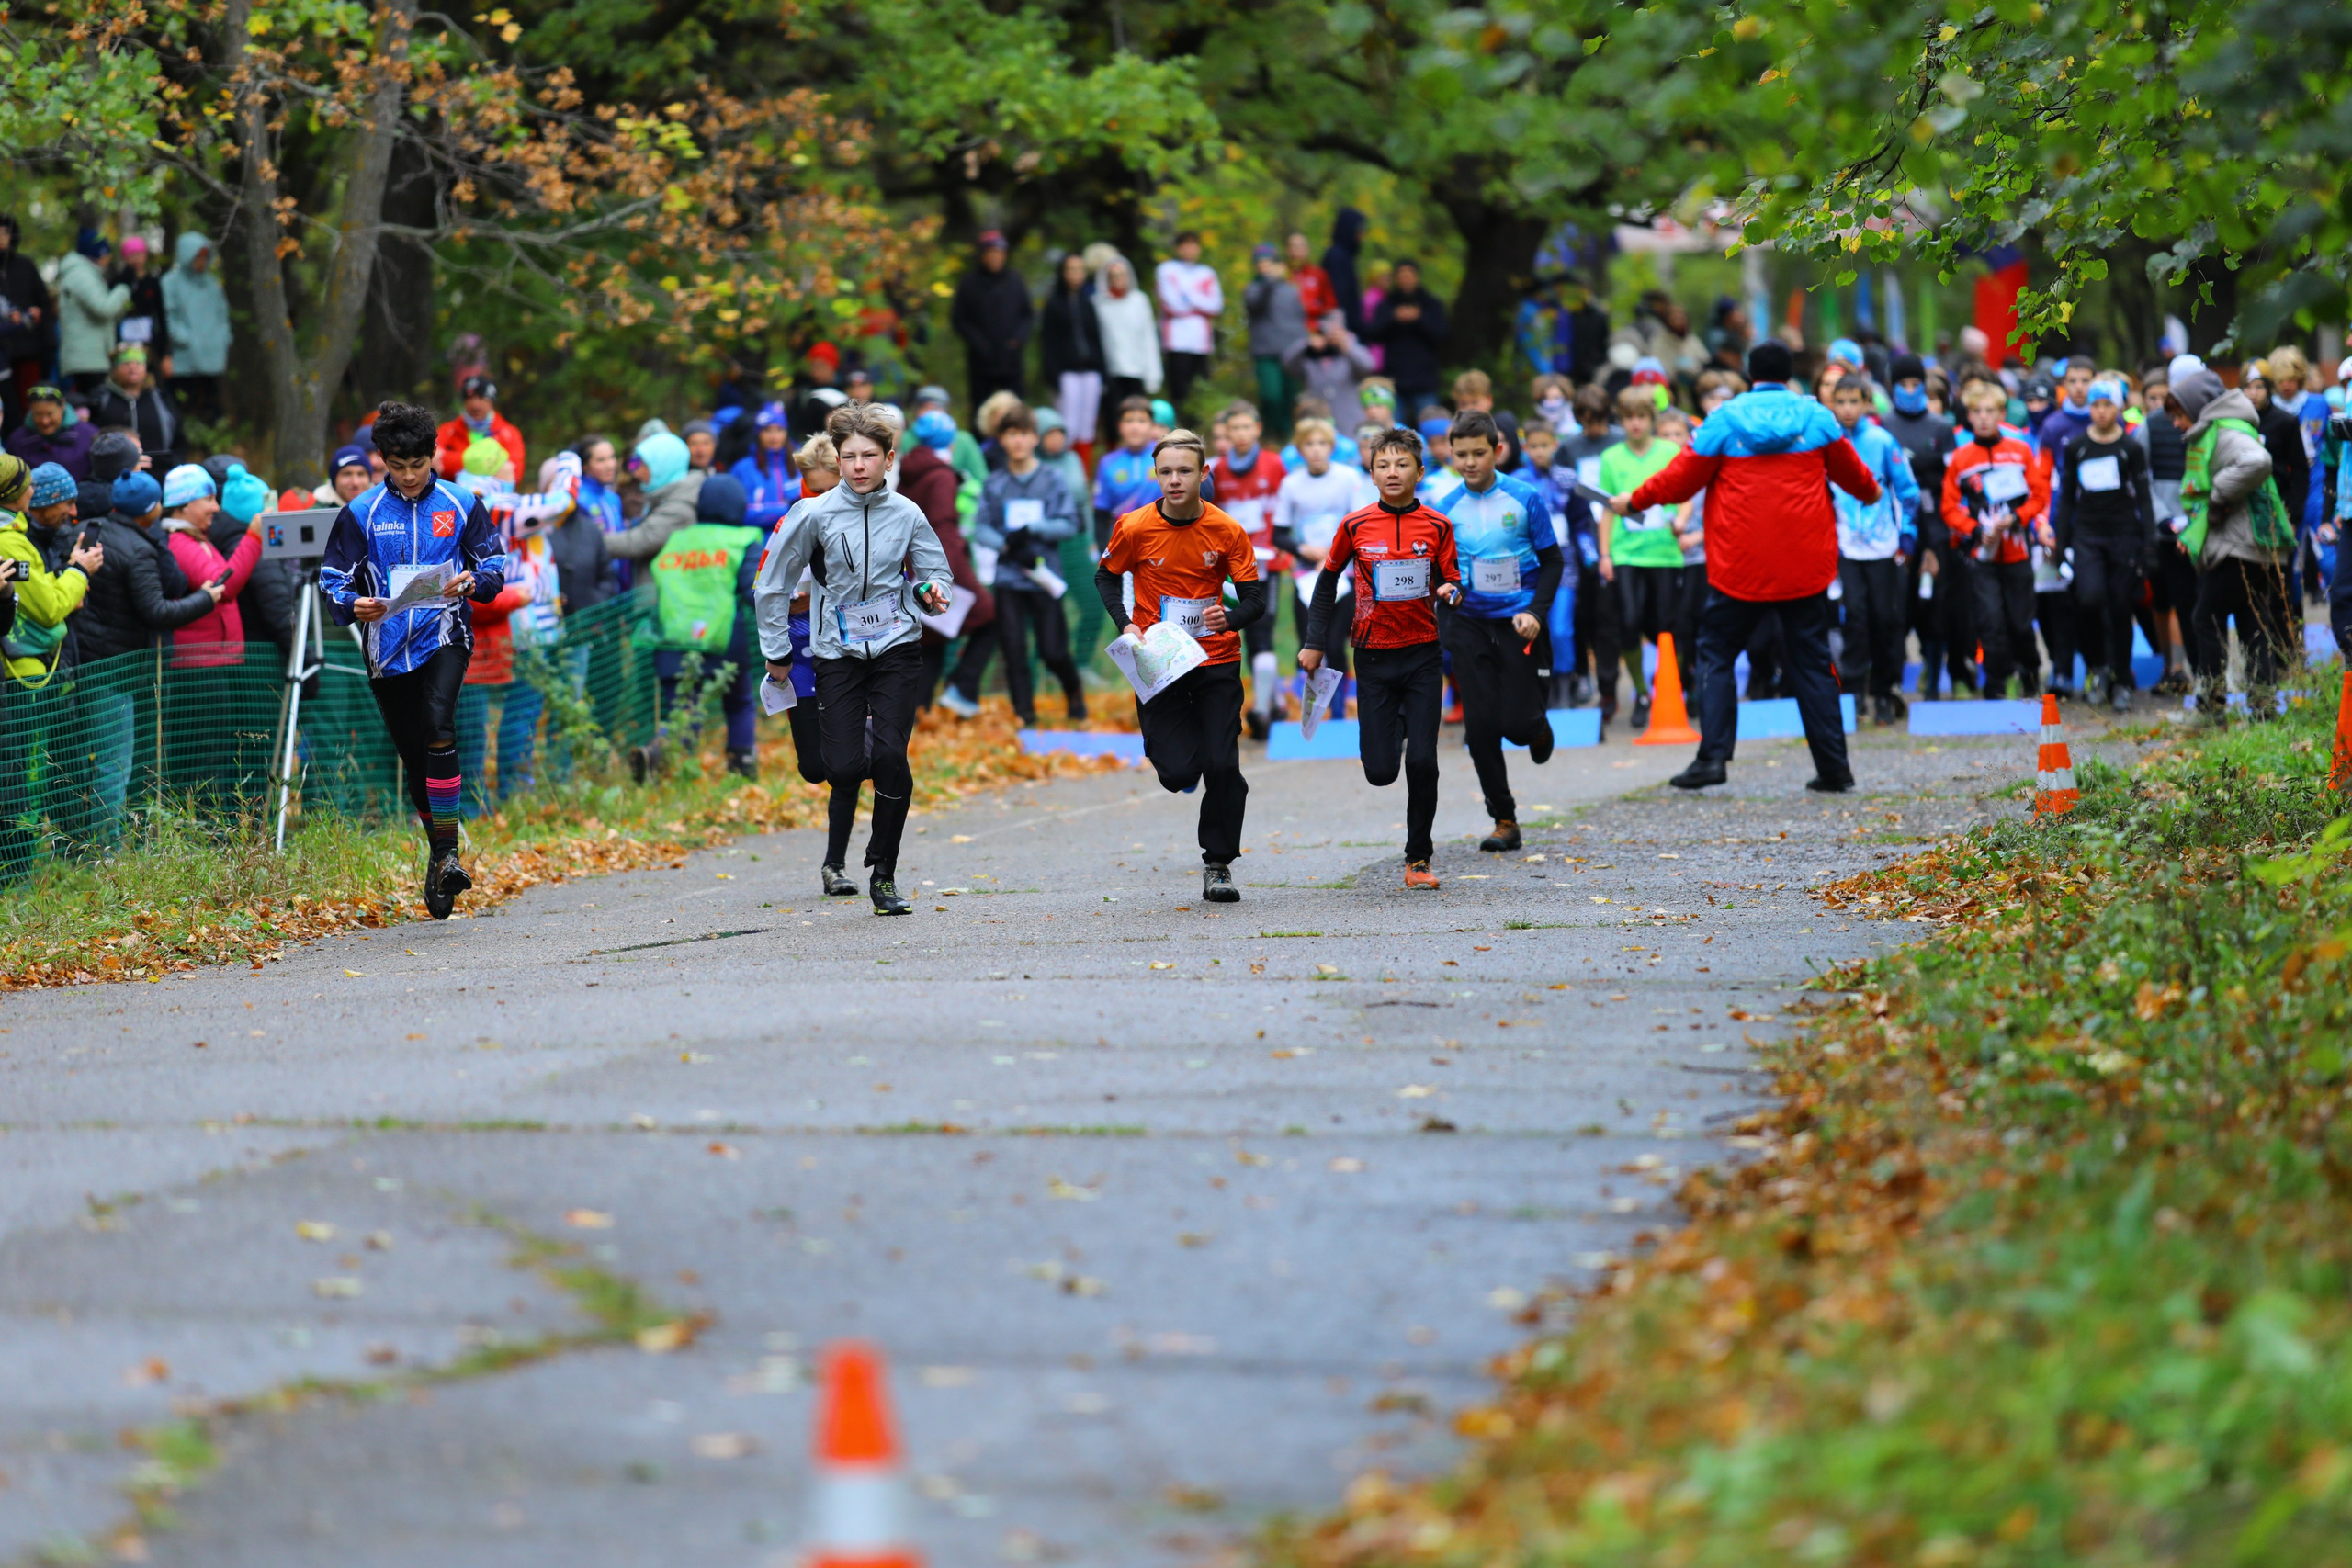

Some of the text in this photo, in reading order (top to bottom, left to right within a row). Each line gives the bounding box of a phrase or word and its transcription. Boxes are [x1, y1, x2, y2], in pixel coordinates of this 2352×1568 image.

[372, 520, 405, 532] kalinka
[659, 549, 728, 573] СУДЬЯ
[1395, 576, 1414, 587] 298
[1485, 573, 1502, 582] 297
[860, 614, 881, 626] 301
[1180, 615, 1200, 626] 300
